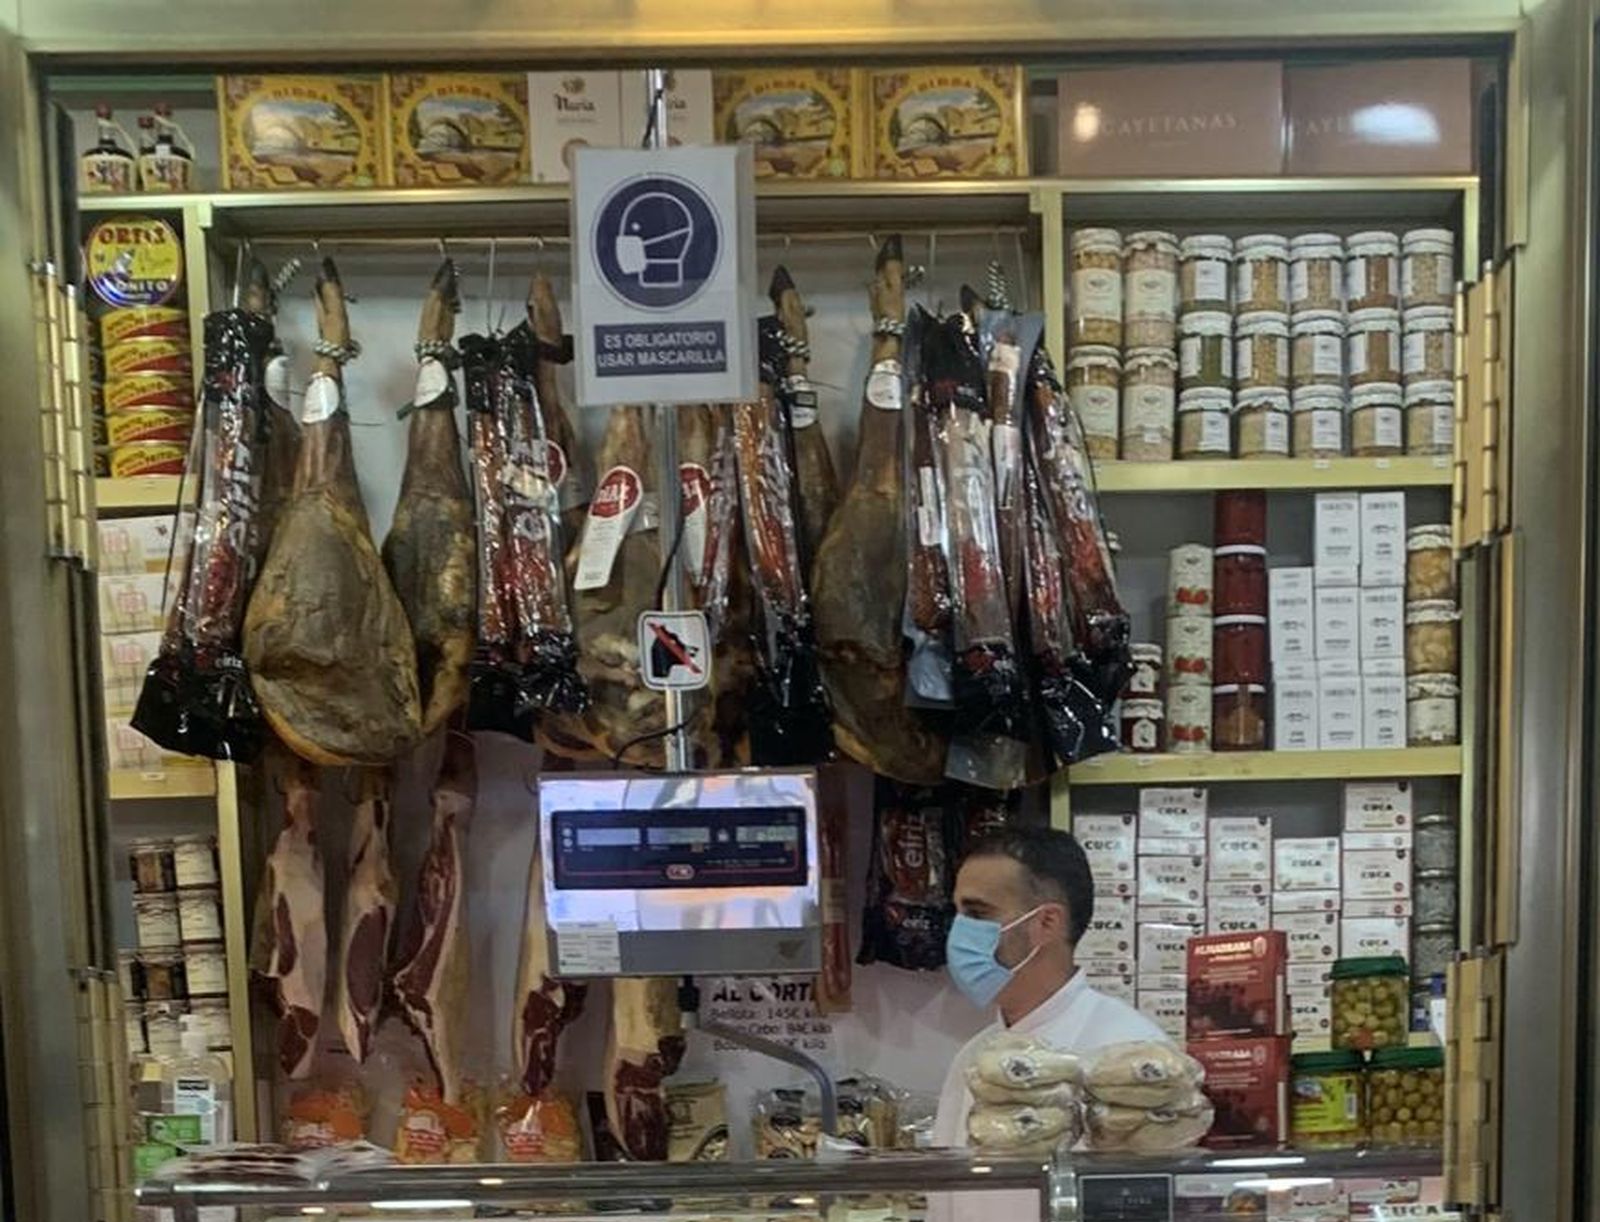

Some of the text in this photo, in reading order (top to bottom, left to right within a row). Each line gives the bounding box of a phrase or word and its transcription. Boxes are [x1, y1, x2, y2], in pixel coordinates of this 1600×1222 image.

[1102, 114, 1238, 136] CAYETANAS
[99, 226, 166, 245] ORTIZ
[603, 331, 717, 349] ES OBLIGATORIO
[597, 350, 726, 367] USAR MASCARILLA
[1363, 803, 1393, 811] CUCA
[1221, 842, 1259, 850] CUCA
[1292, 859, 1322, 867] CUCA
[1361, 871, 1391, 879] CUCA
[1157, 876, 1186, 884] CUCA
[1219, 921, 1258, 930] CUCA
[1291, 933, 1321, 941] CUCA
[1360, 939, 1389, 947] CUCA
[1381, 1205, 1438, 1216] CUCA
